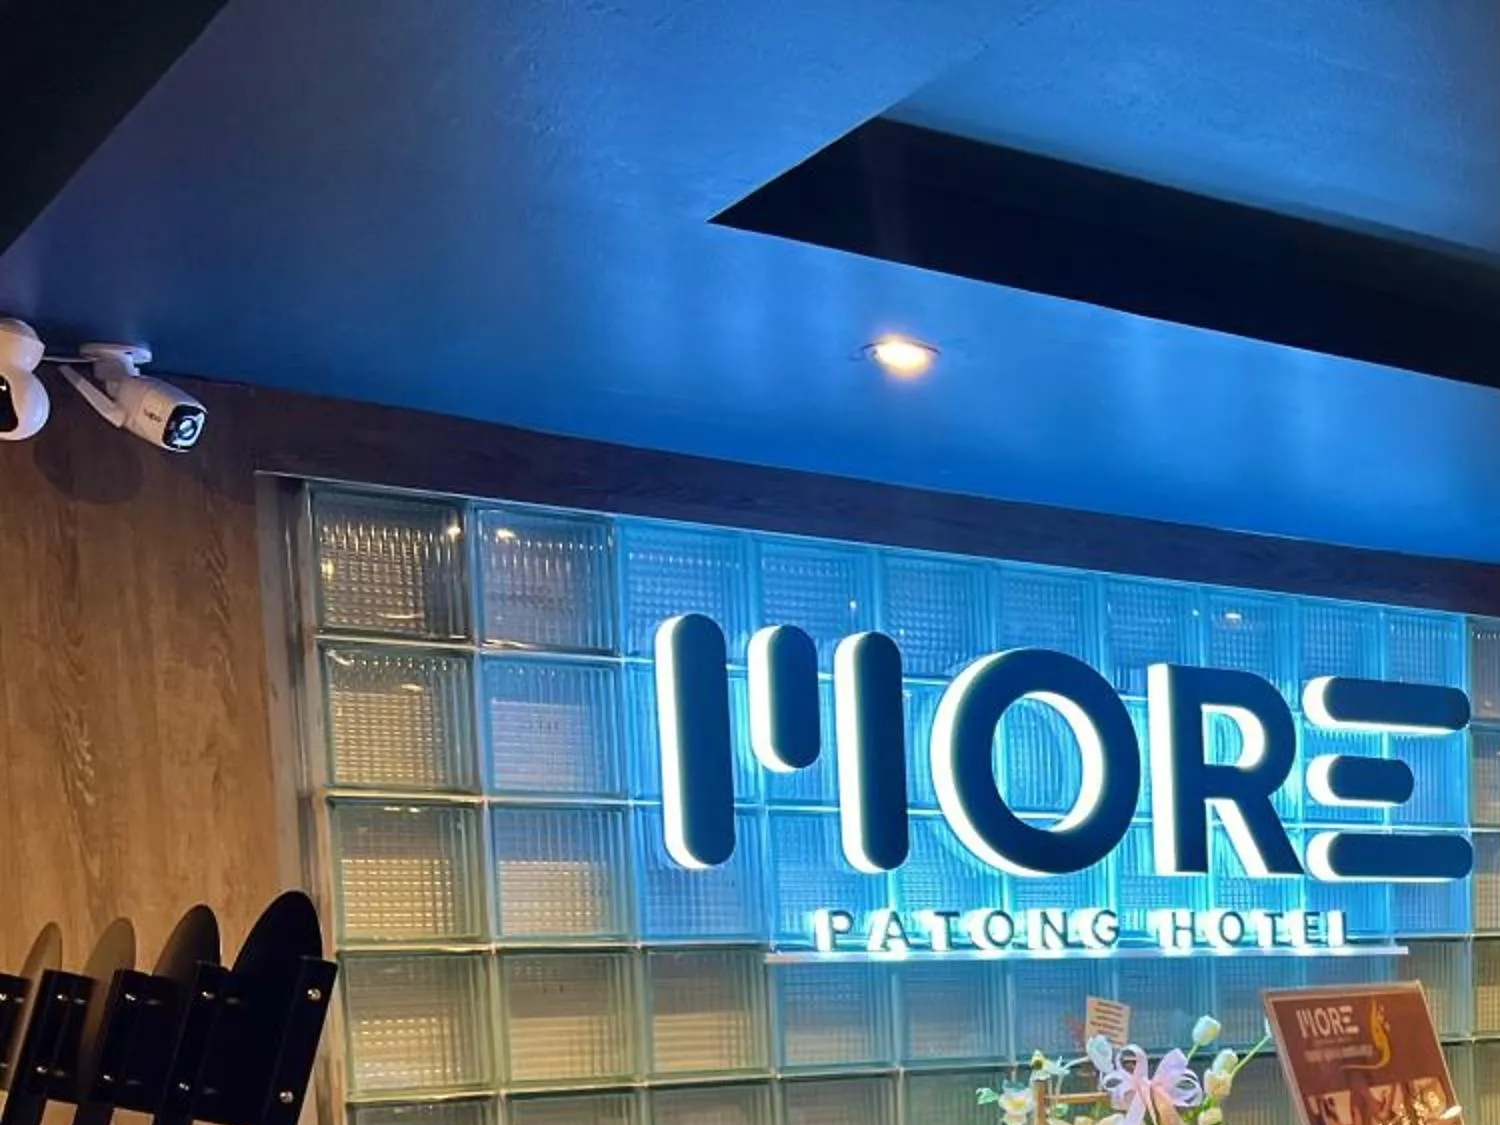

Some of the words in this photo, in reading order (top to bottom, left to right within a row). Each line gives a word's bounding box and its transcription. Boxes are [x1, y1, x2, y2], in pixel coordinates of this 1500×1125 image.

[655, 613, 1473, 881] MORE
[813, 908, 1121, 954] PATONG
[1155, 909, 1363, 952] HOTEL
[1295, 1005, 1359, 1039] MORE
